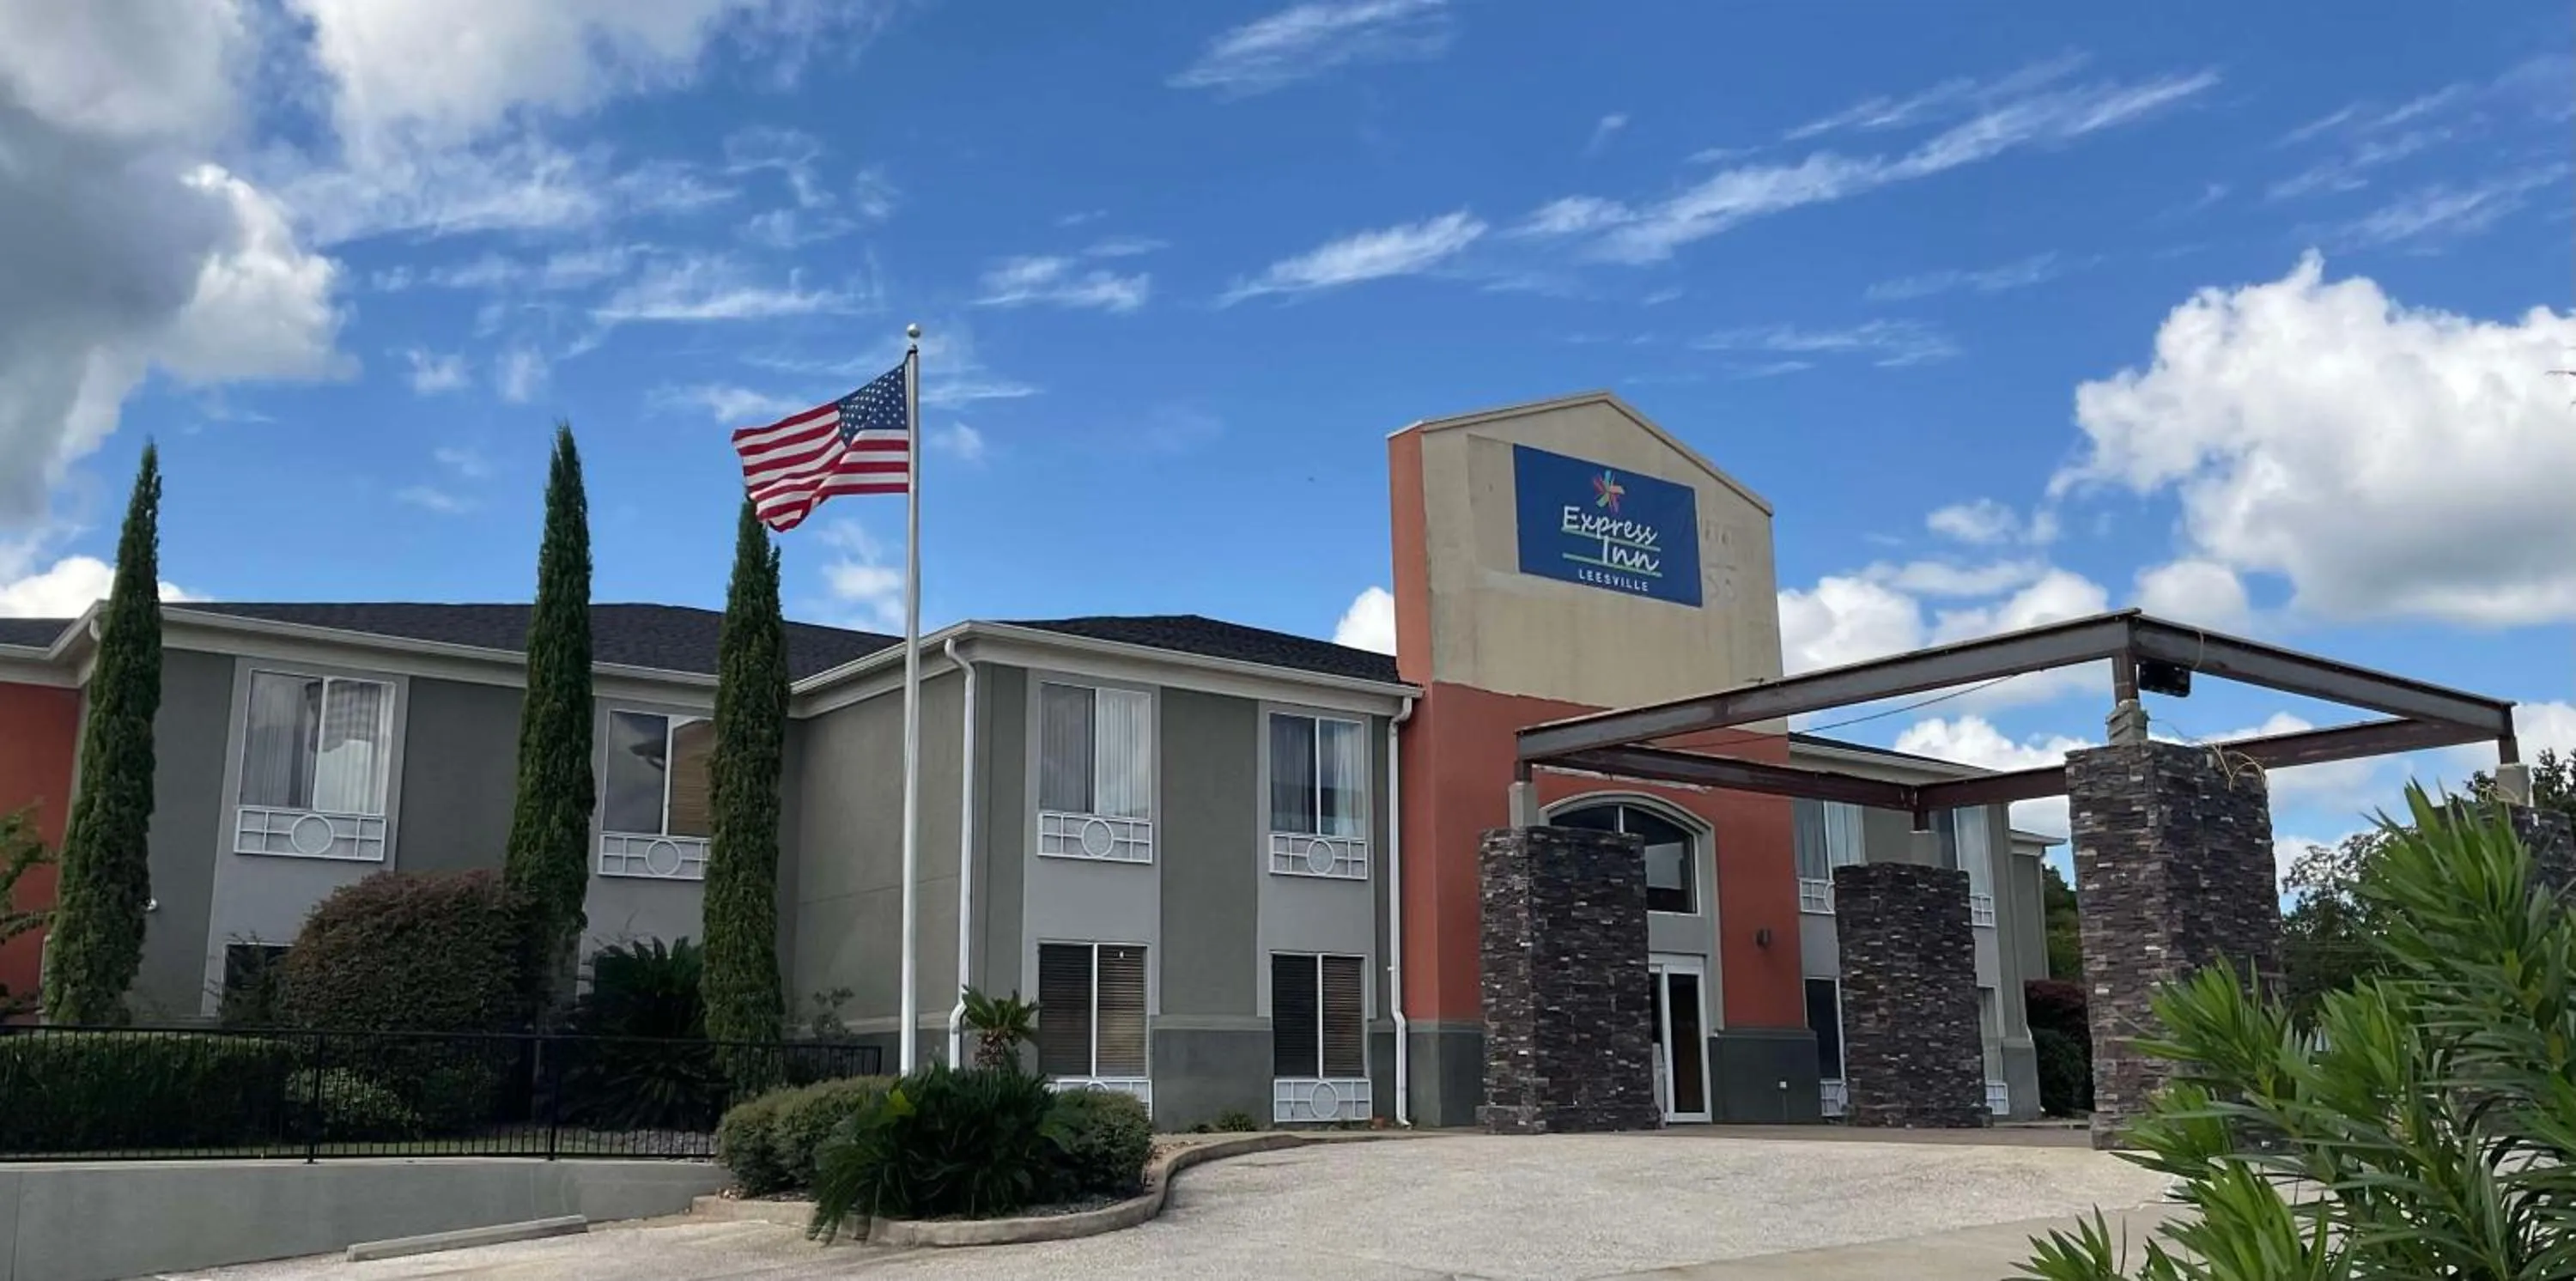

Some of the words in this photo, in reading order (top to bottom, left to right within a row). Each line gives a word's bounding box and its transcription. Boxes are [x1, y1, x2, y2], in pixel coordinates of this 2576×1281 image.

[1563, 506, 1657, 544] Express
[1602, 536, 1659, 571] Inn
[1578, 568, 1649, 591] LEESVILLE
